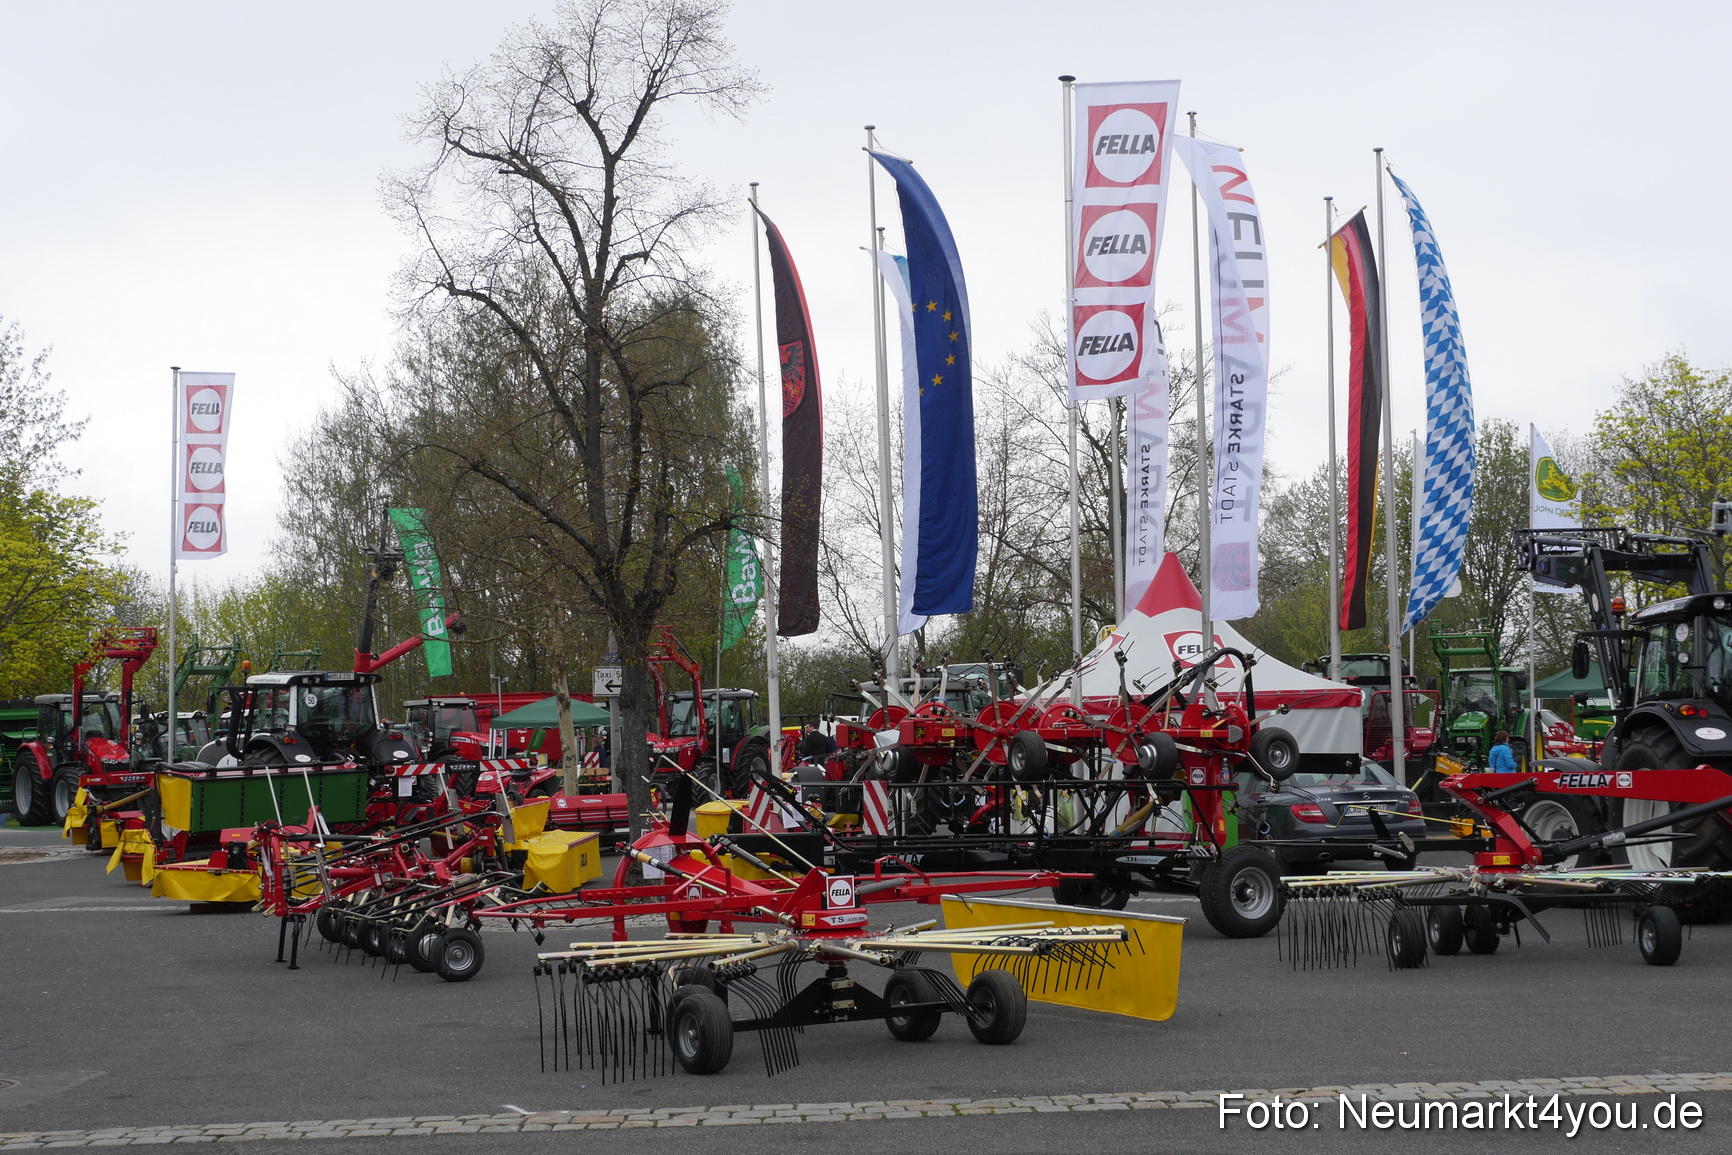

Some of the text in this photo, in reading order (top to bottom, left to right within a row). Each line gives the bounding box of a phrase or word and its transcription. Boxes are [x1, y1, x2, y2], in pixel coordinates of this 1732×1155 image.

[1095, 133, 1156, 156] FELLA
[1086, 233, 1148, 257] FELLA
[1077, 332, 1135, 357] FELLA
[190, 461, 224, 474] FELLA
[1533, 505, 1554, 515] JOHN
[187, 521, 219, 534] FELLA
[308, 696, 319, 705] 50
[1558, 772, 1609, 788] FELLA
[831, 888, 851, 897] FELLA
[830, 916, 845, 924] TS
